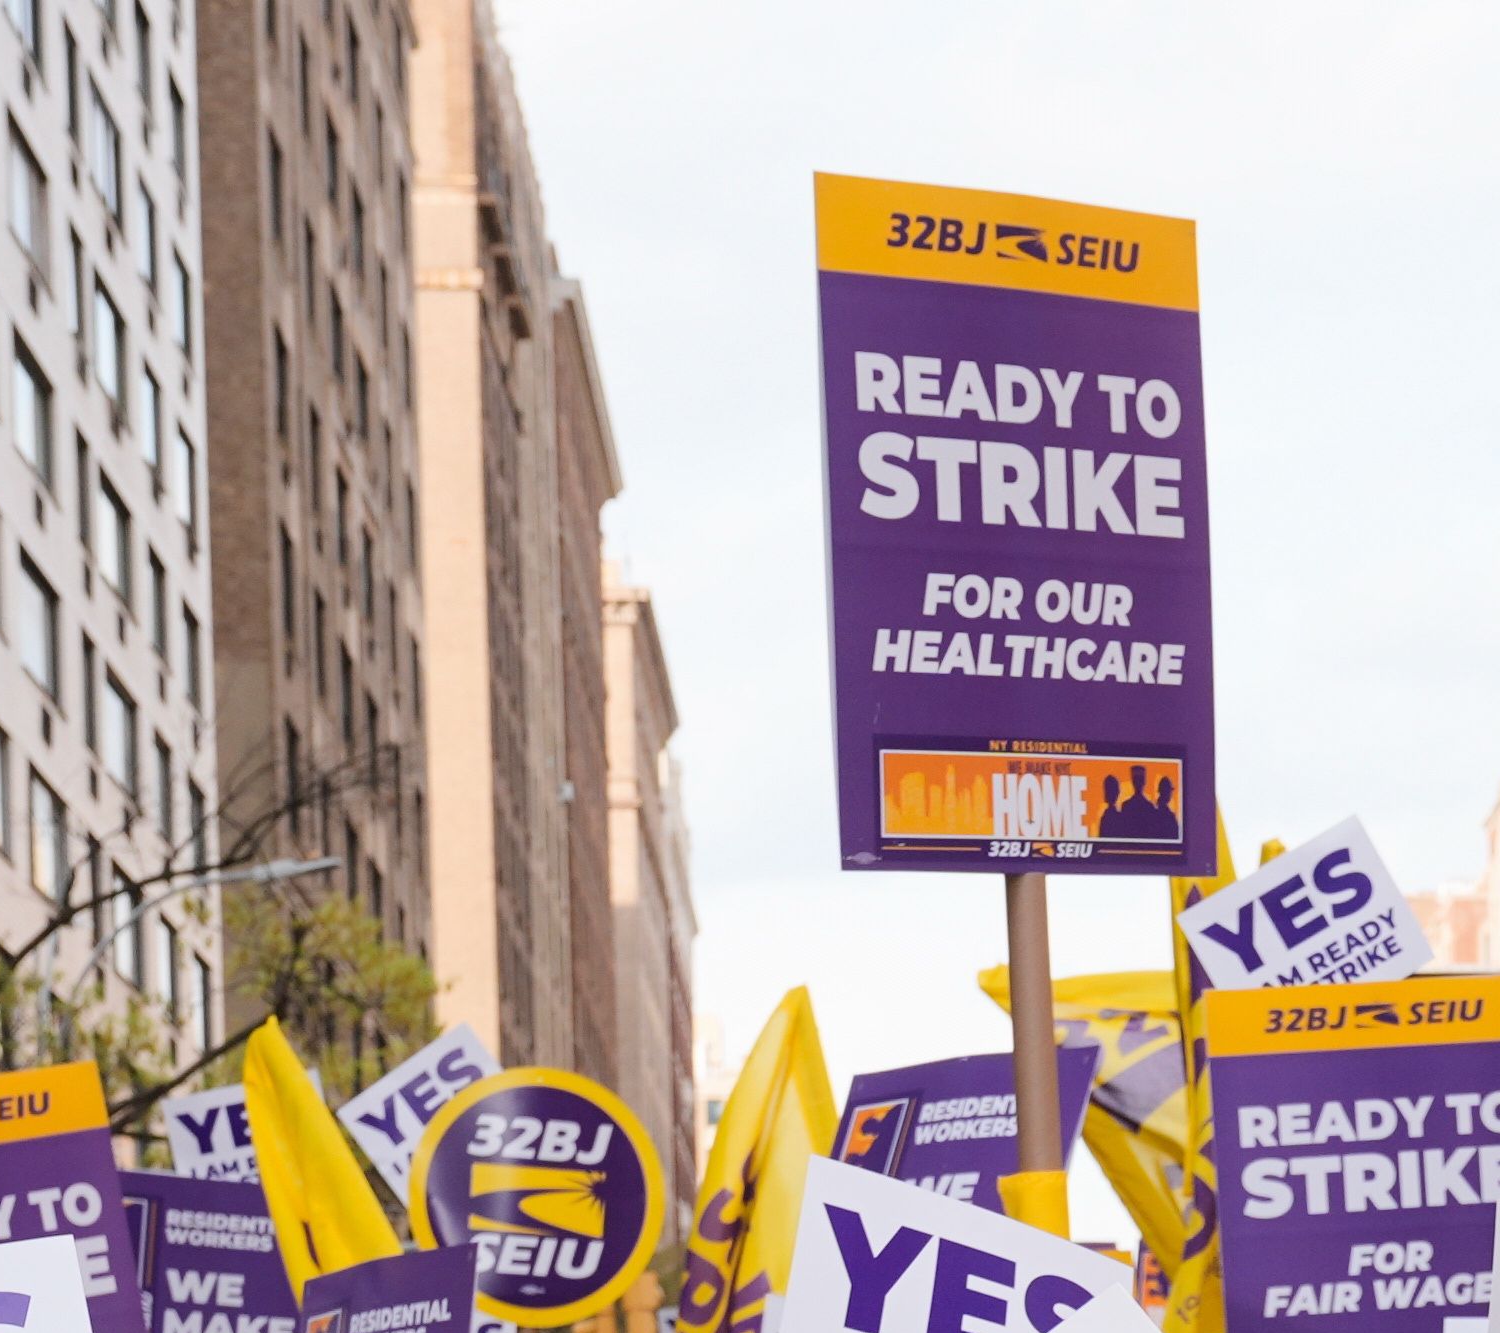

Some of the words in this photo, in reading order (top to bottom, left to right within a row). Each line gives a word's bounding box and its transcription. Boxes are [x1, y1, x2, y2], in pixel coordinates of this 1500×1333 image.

[887, 214, 988, 256] 32BJ
[1056, 232, 1141, 274] SEIU
[854, 351, 1083, 429] READY
[1098, 373, 1182, 438] TO
[857, 431, 1186, 539] STRIKE
[921, 572, 1024, 622] FOR
[1036, 578, 1133, 627] OUR
[871, 628, 1187, 685] HEALTHCARE
[989, 740, 1007, 751] NY
[1012, 740, 1088, 754] RESIDENTIAL
[992, 773, 1089, 838] HOME
[988, 841, 1031, 858] 32BJ
[1056, 842, 1093, 858] SEIU
[1201, 848, 1372, 974] YES
[1308, 909, 1397, 974] READY
[1265, 1006, 1346, 1034] 32BJ
[1408, 1000, 1486, 1025] SEIU
[468, 1114, 612, 1165] 32BJ
[1238, 1096, 1436, 1149] READY
[166, 1228, 274, 1252] WORKERS
[475, 1232, 604, 1279] SEIU
[1347, 1241, 1435, 1278] FOR
[164, 1268, 245, 1308] WE
[1265, 1278, 1362, 1319] FAIR
[349, 1298, 452, 1332] RESIDENTIAL
